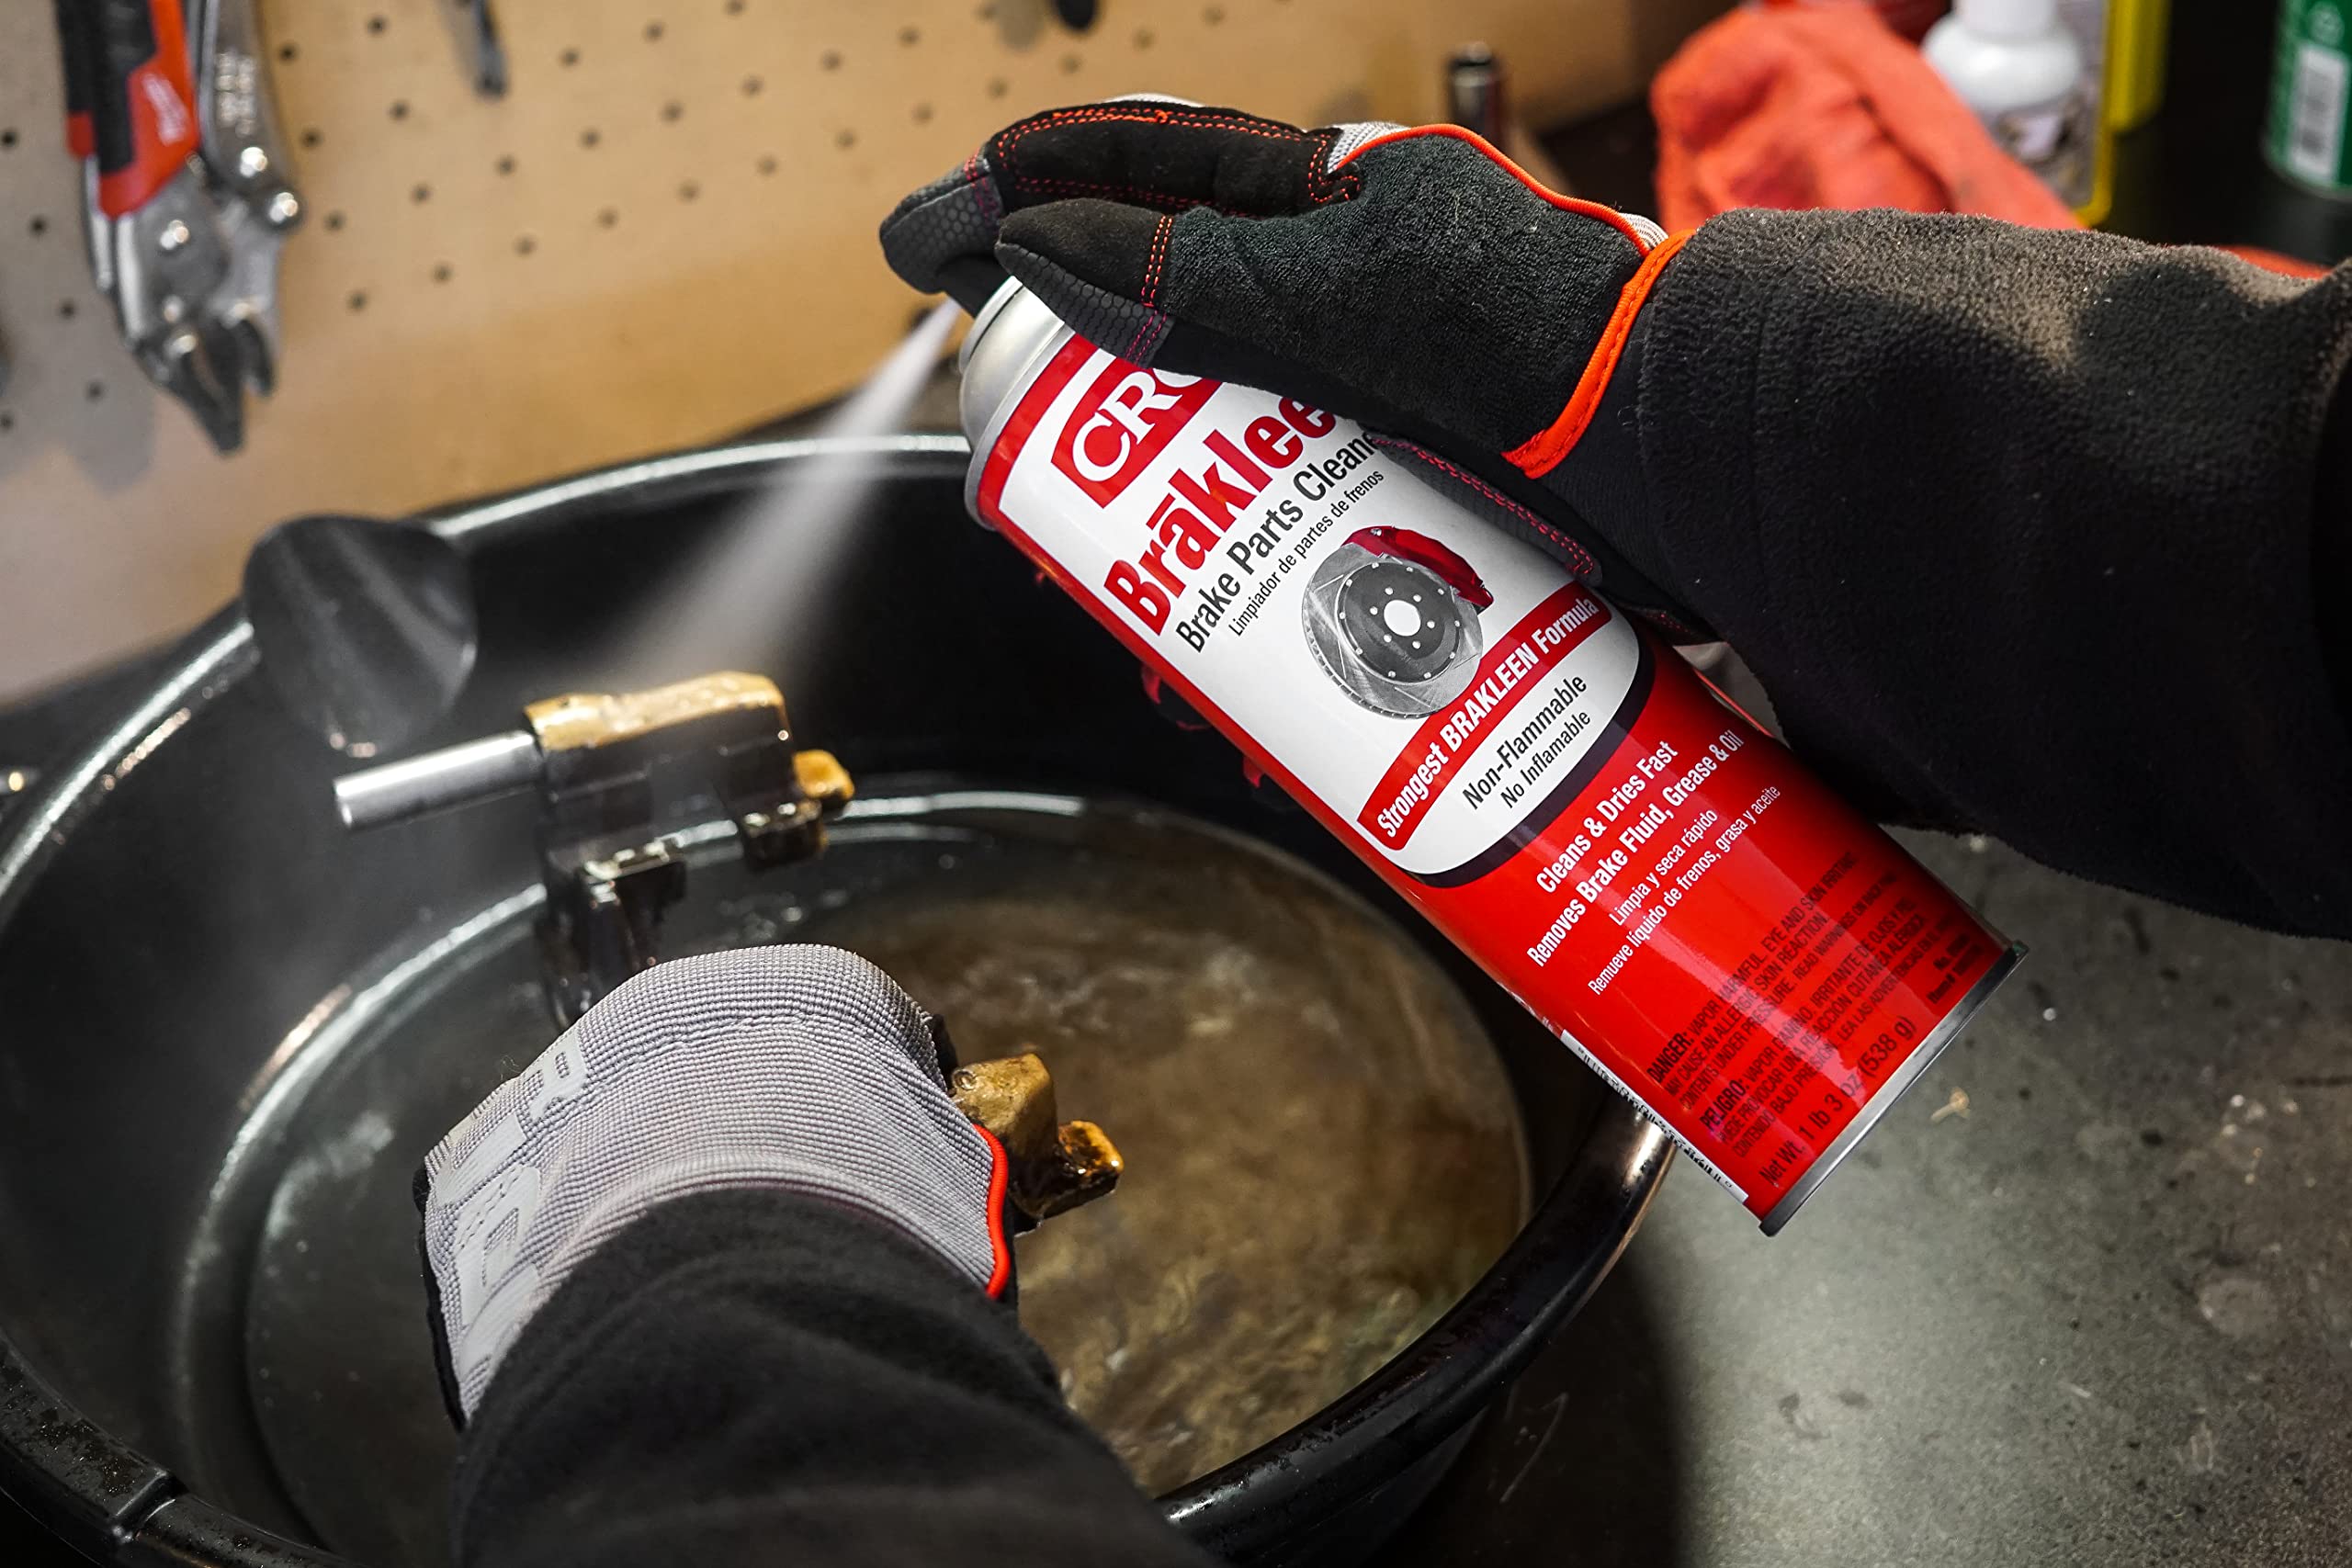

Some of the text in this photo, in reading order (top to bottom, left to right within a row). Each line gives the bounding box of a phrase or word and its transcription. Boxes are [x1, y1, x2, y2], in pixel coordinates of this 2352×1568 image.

[1103, 397, 1336, 636] Brāklee
[1176, 432, 1378, 652] Brake Parts Cleane
[1228, 471, 1384, 637] Limpiador de partes de frenos
[1375, 597, 1598, 837] Strongest BRAKLEEN Formula
[1463, 677, 1586, 808] Non-Flammable
[1500, 711, 1590, 807] No Inflamable
[1527, 730, 1743, 965] Removes Brake Fluid, Grease & Oil
[1536, 739, 1678, 892] Cleans & Dries Fast
[1588, 784, 1780, 994] Remueve líquido de frenos, grasa y aceite
[1610, 809, 1717, 925] Limpia y seca rápido
[1647, 1030, 1692, 1081] DANGER:
[1688, 1000, 1720, 1035] VAPOR
[1762, 928, 1785, 952] EYE
[1780, 906, 1805, 931] AND
[1800, 885, 1826, 910] SKIN
[1665, 1076, 1683, 1094] MAY
[1677, 1048, 1705, 1080] CAUSE
[1701, 1033, 1717, 1052] AN
[1713, 987, 1758, 1037] ALLERGIC
[1754, 961, 1781, 989] SKIN
[1680, 1065, 1718, 1108] CONTENTS
[1713, 1032, 1746, 1068] UNDER
[1793, 953, 1818, 979] READ
[1702, 1077, 1747, 1129] PELIGRO:
[1744, 1046, 1777, 1082] VAPOR
[1810, 953, 1860, 1007] IRRITANTE
[1855, 940, 1873, 957] DE
[1733, 1110, 1775, 1156] CONTENIDO
[1770, 1084, 1797, 1112] BAJO
[1838, 1021, 1856, 1040] LEA
[1852, 1002, 1872, 1022] LAS
[1738, 1068, 1784, 1120] PROVOCAR
[1780, 1045, 1804, 1071] UNA
[1759, 1014, 1917, 1183] Net Wt. 1 lb 3 oz (538 g)
